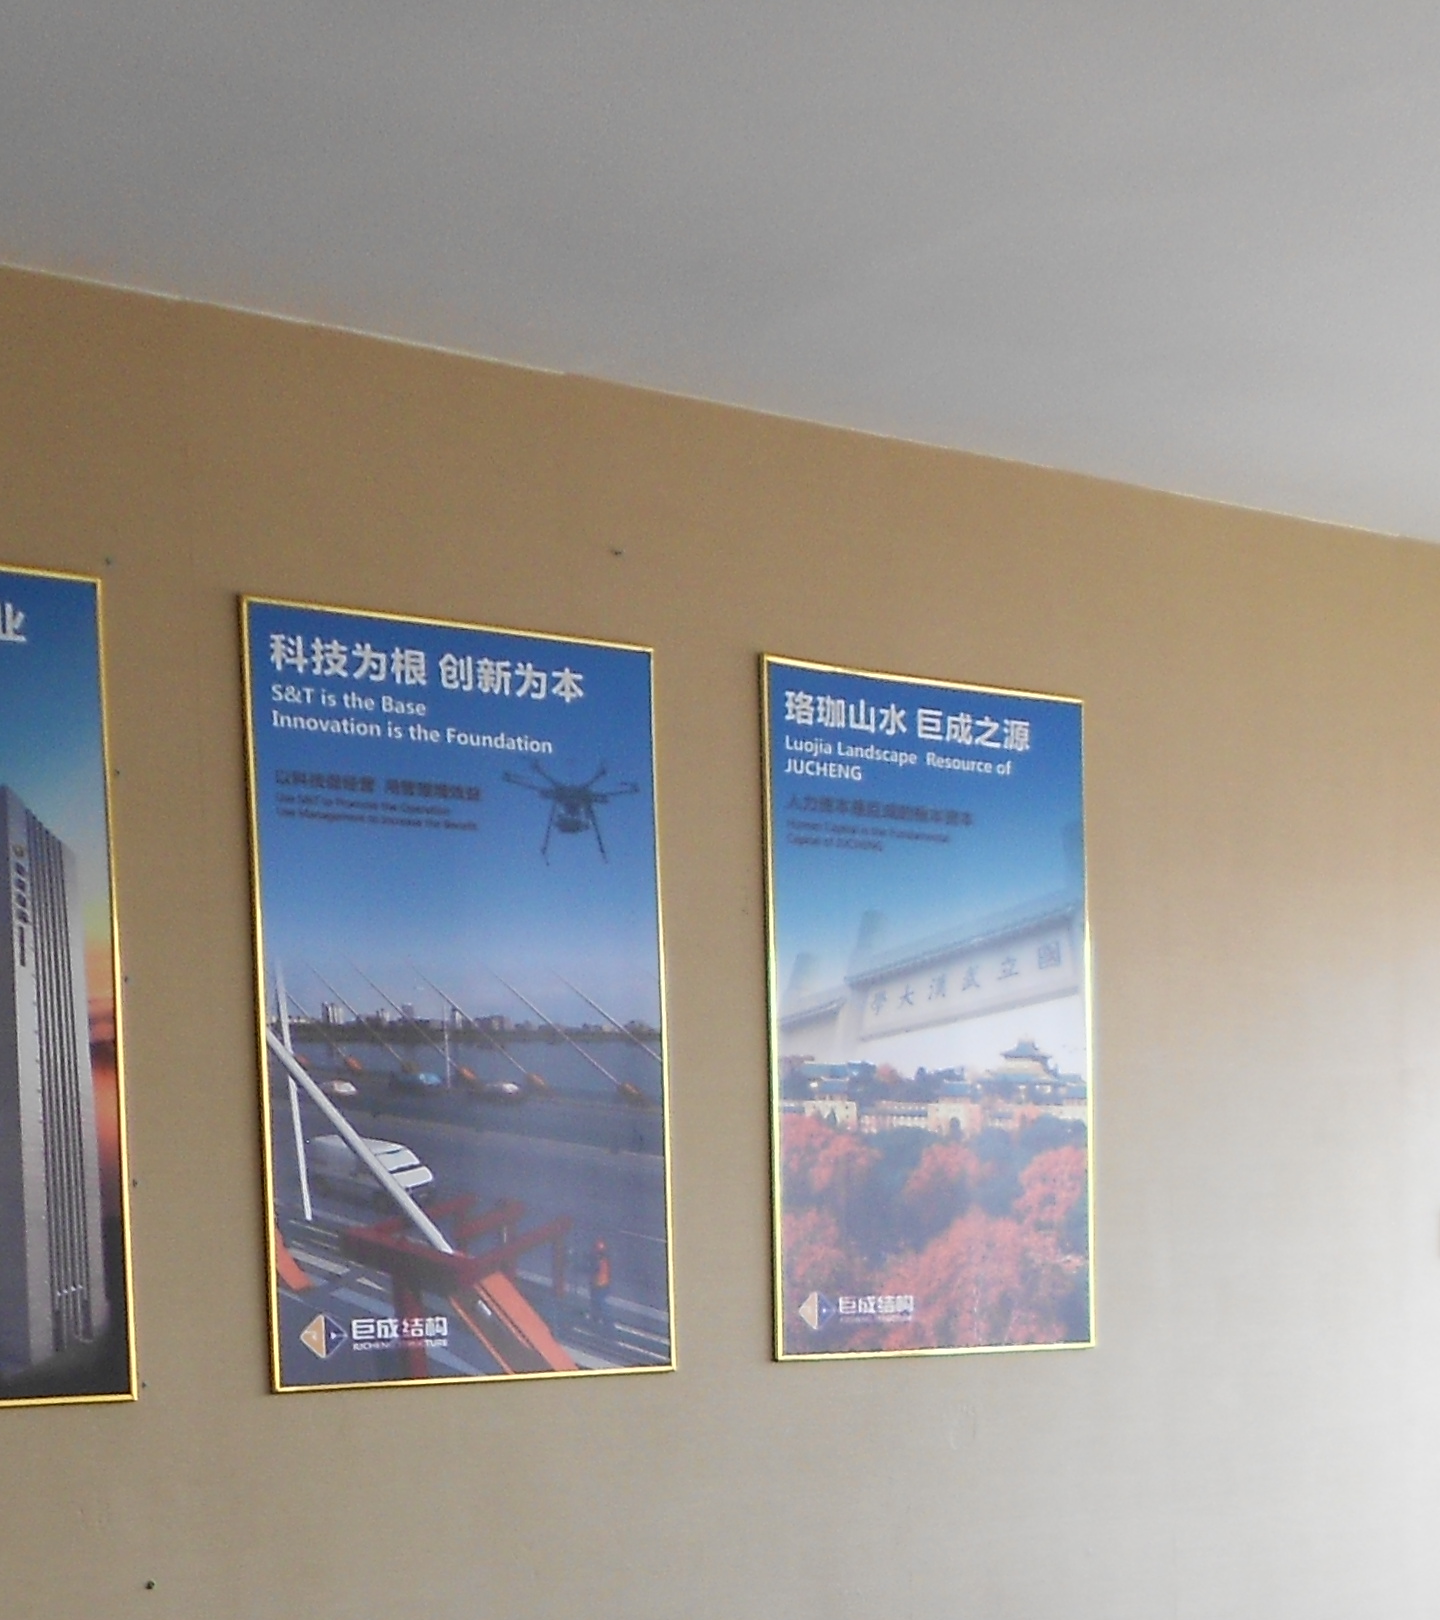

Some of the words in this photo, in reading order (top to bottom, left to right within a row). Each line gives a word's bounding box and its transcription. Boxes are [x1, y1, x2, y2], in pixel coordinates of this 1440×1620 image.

[269, 632, 429, 687] 科技为根
[438, 653, 585, 704] 创新为本
[271, 684, 315, 705] S&T
[320, 689, 337, 708] is
[343, 691, 376, 712] the
[381, 695, 427, 717] Base
[784, 690, 907, 736] 珞珈山水
[916, 707, 1031, 752] 巨成之源
[271, 709, 381, 739] Innovation
[387, 719, 404, 739] is
[409, 721, 440, 744] the
[446, 726, 554, 755] Foundation
[784, 758, 863, 782] JUCHENG
[785, 734, 832, 757] Luojia
[837, 741, 918, 768] Landscape
[926, 751, 992, 775] Resource
[996, 760, 1012, 776] of
[351, 1316, 448, 1340] 巨成结构
